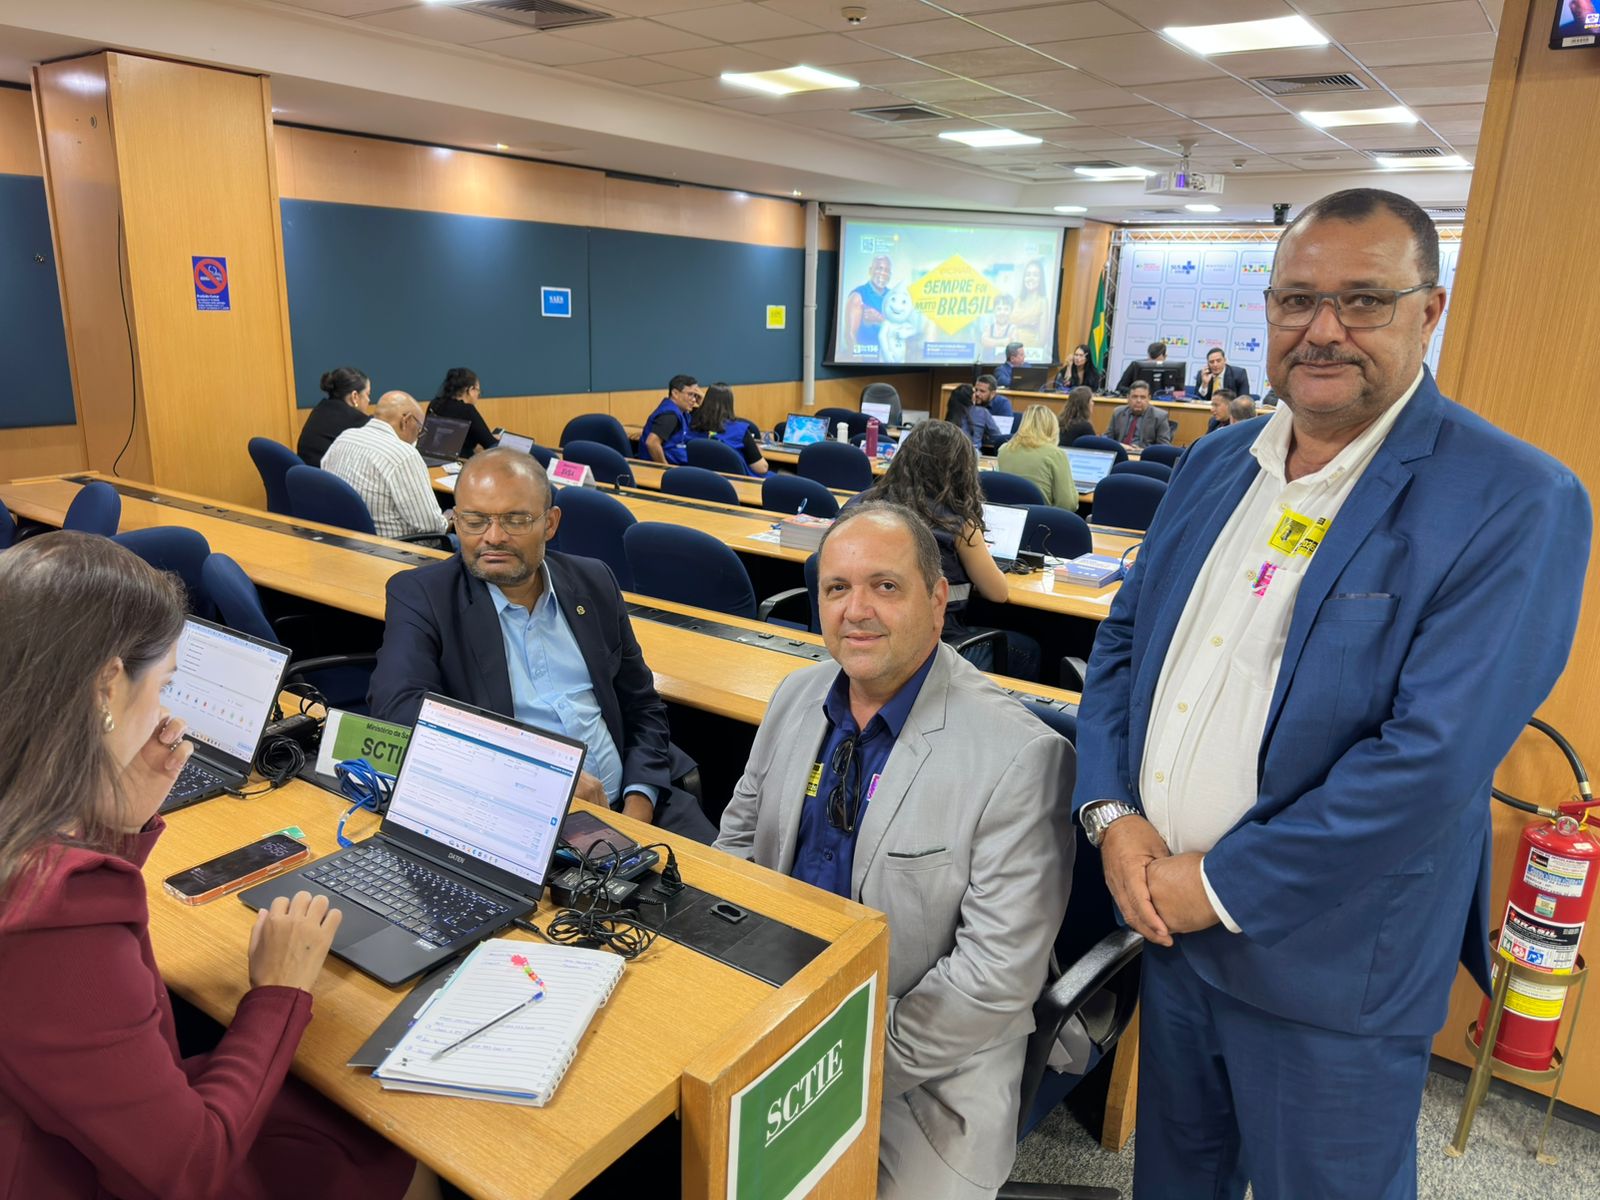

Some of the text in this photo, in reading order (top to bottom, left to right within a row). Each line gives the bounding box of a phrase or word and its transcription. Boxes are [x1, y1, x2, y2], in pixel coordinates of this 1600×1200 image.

[923, 279, 974, 295] SEMPRE
[937, 296, 994, 316] BRASIL
[361, 738, 403, 765] SCTI
[765, 1039, 844, 1143] SCTIE
